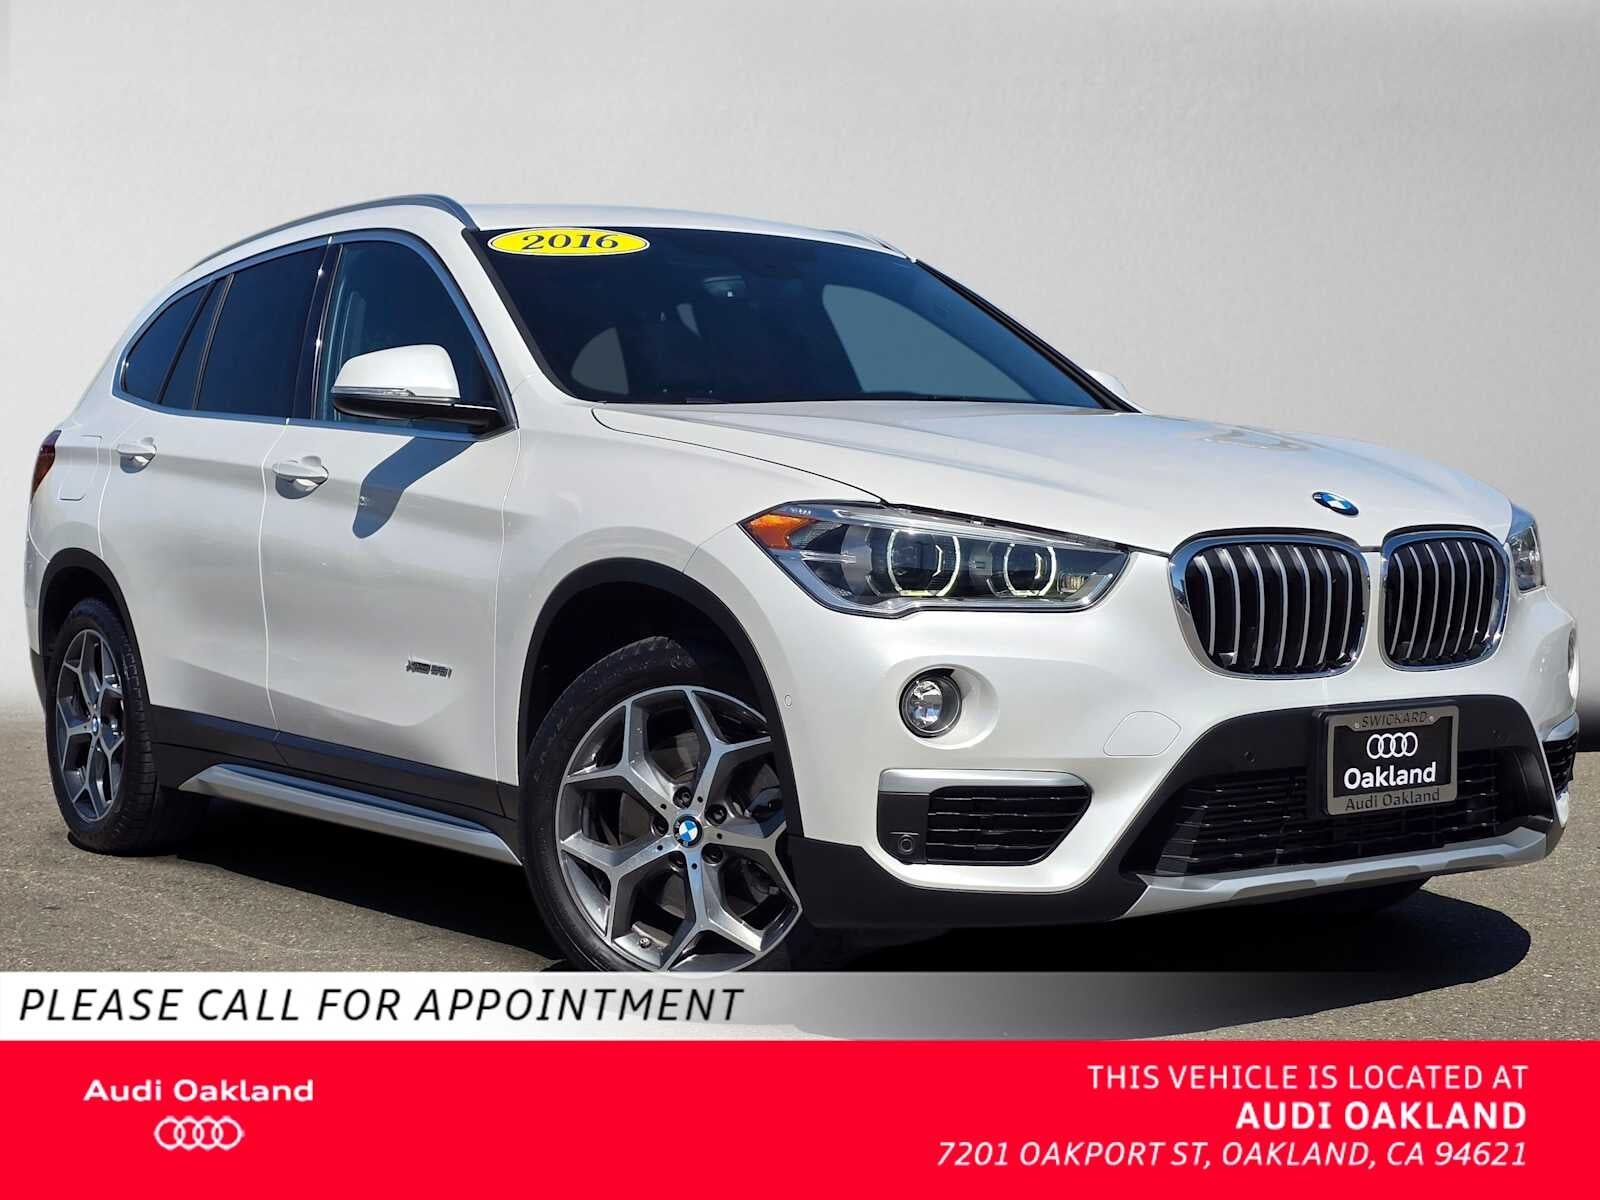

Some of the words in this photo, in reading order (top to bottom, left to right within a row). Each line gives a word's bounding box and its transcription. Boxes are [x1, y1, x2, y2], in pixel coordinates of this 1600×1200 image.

[521, 234, 619, 250] 2016
[1361, 711, 1428, 728] SWICKARD
[1343, 761, 1437, 790] Oakland
[1344, 795, 1378, 811] Audi
[1382, 788, 1441, 806] Oakland
